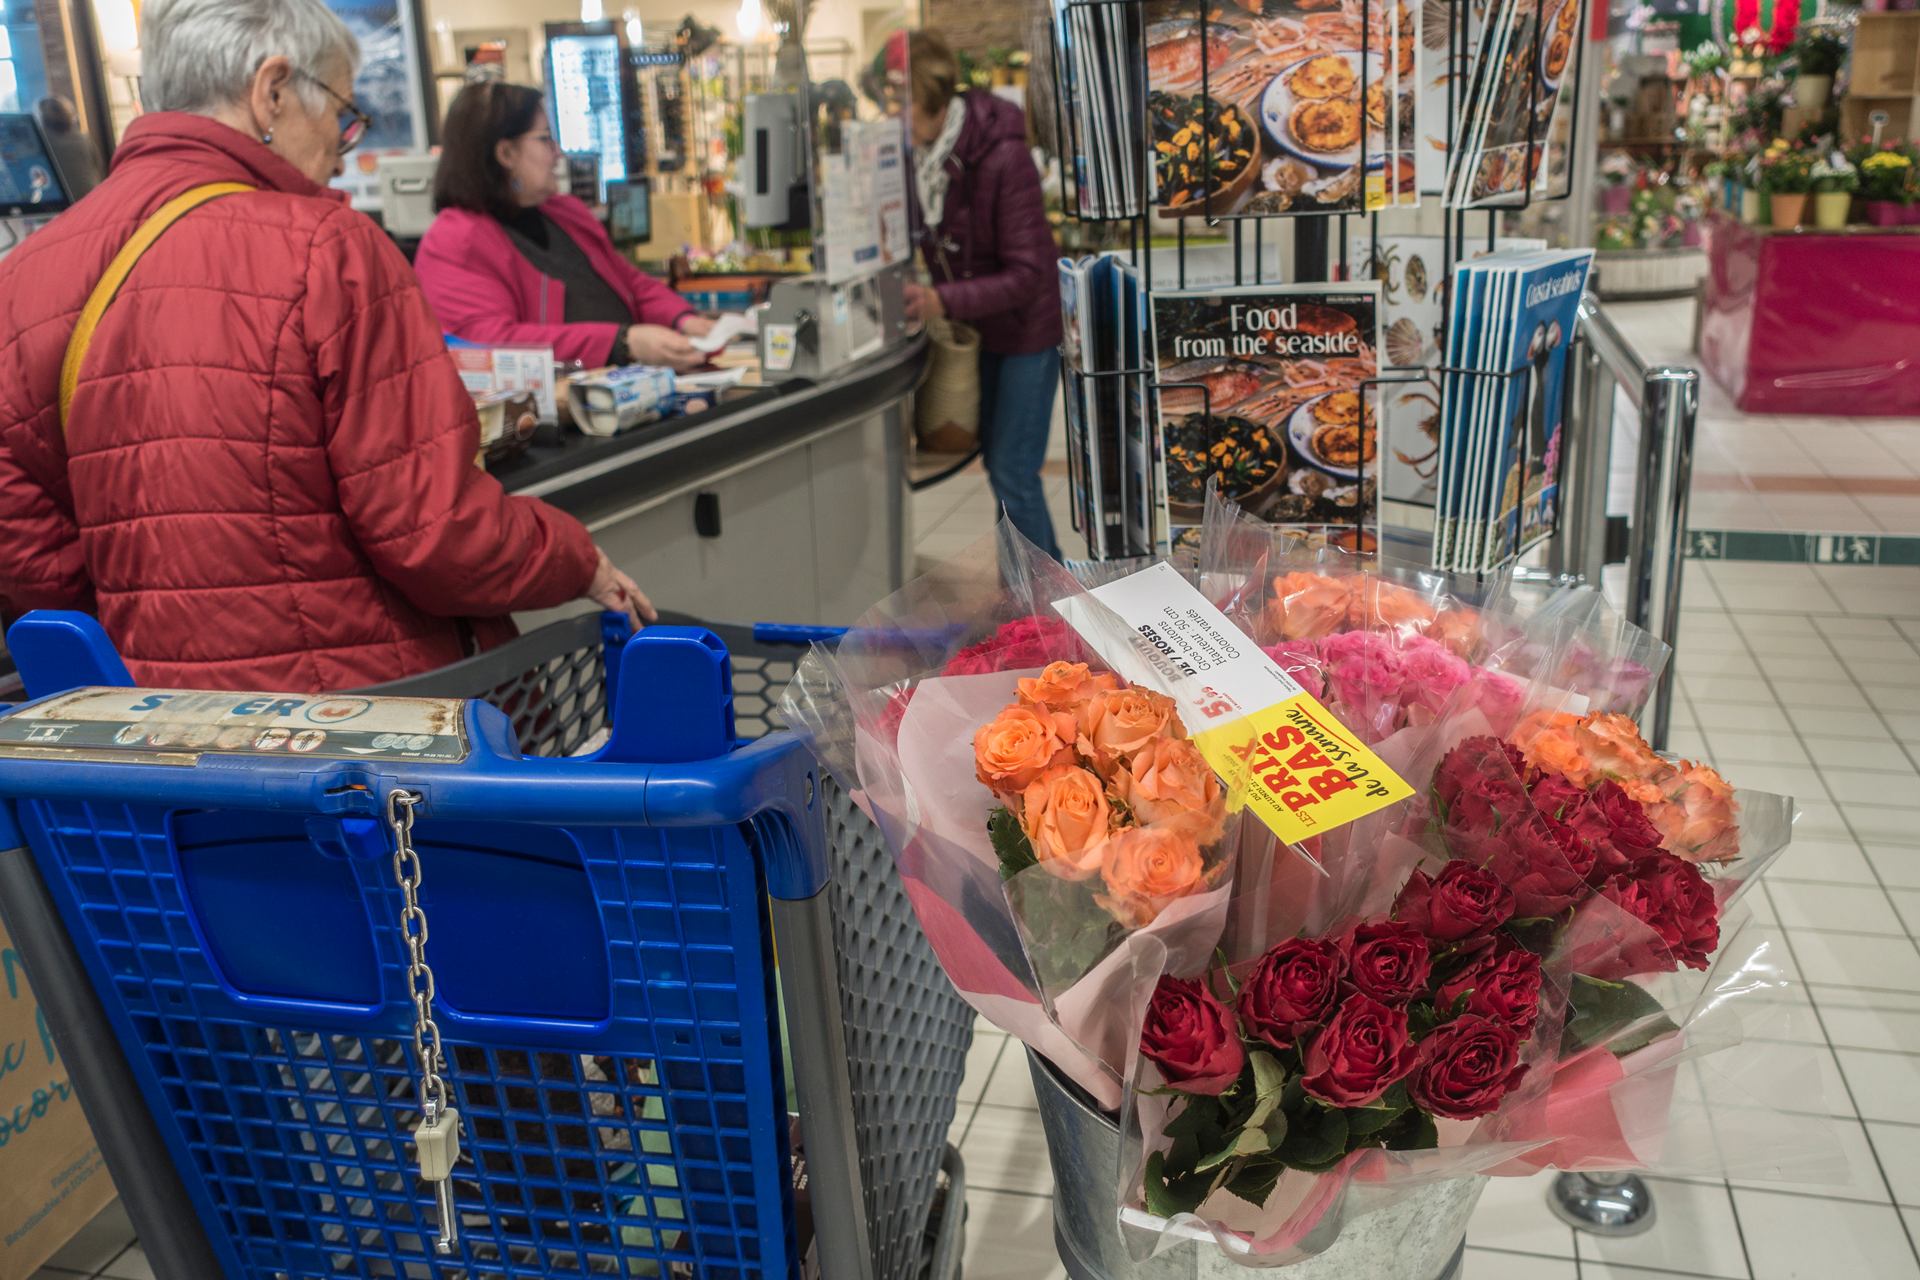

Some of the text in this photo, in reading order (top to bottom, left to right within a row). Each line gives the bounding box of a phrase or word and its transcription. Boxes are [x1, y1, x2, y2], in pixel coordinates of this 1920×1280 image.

[1230, 302, 1297, 332] Food
[1174, 331, 1359, 359] from the seaside
[1162, 606, 1179, 620] cm
[1173, 618, 1190, 631] 50
[1136, 623, 1175, 656] ROSES
[1156, 620, 1211, 671] Gros boutons
[1184, 607, 1241, 659] Coloris variés
[1128, 635, 1182, 682] BOUQUET
[1190, 632, 1227, 666] Hauteur
[1176, 660, 1198, 677] DE
[129, 694, 306, 717] SUPER
[1262, 725, 1358, 800] BAS
[1286, 708, 1390, 798] de la semaine
[1229, 738, 1319, 811] PRIX
[1255, 786, 1274, 802] LUNDI
[1270, 801, 1283, 812] AU
[1294, 810, 1317, 828] LES
